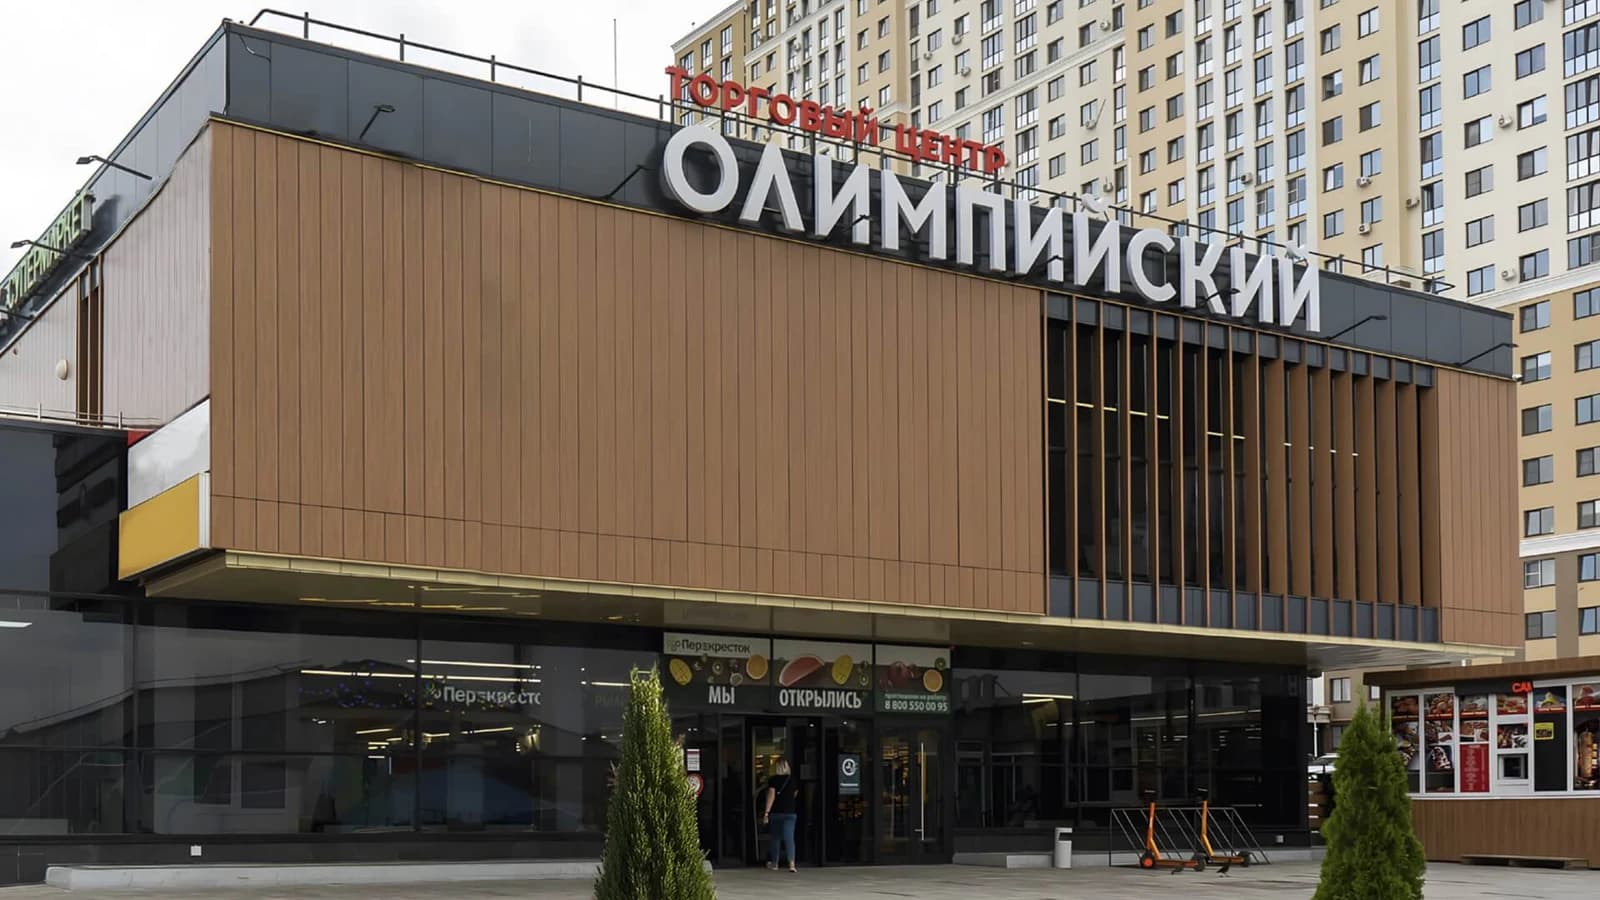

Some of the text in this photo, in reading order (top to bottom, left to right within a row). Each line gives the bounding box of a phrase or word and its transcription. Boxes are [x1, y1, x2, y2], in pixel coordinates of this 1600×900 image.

[665, 66, 1007, 174] ТОРГОВЫЙ ЦЕНТР
[6, 188, 96, 309] СУПЕРМАРКЕТ
[663, 126, 1321, 333] ОЛИМПИЙСКИЙ
[708, 685, 862, 709] МЫ ОТКРЫЛИСЬ
[884, 701, 949, 712] 8 800 550 00 95
